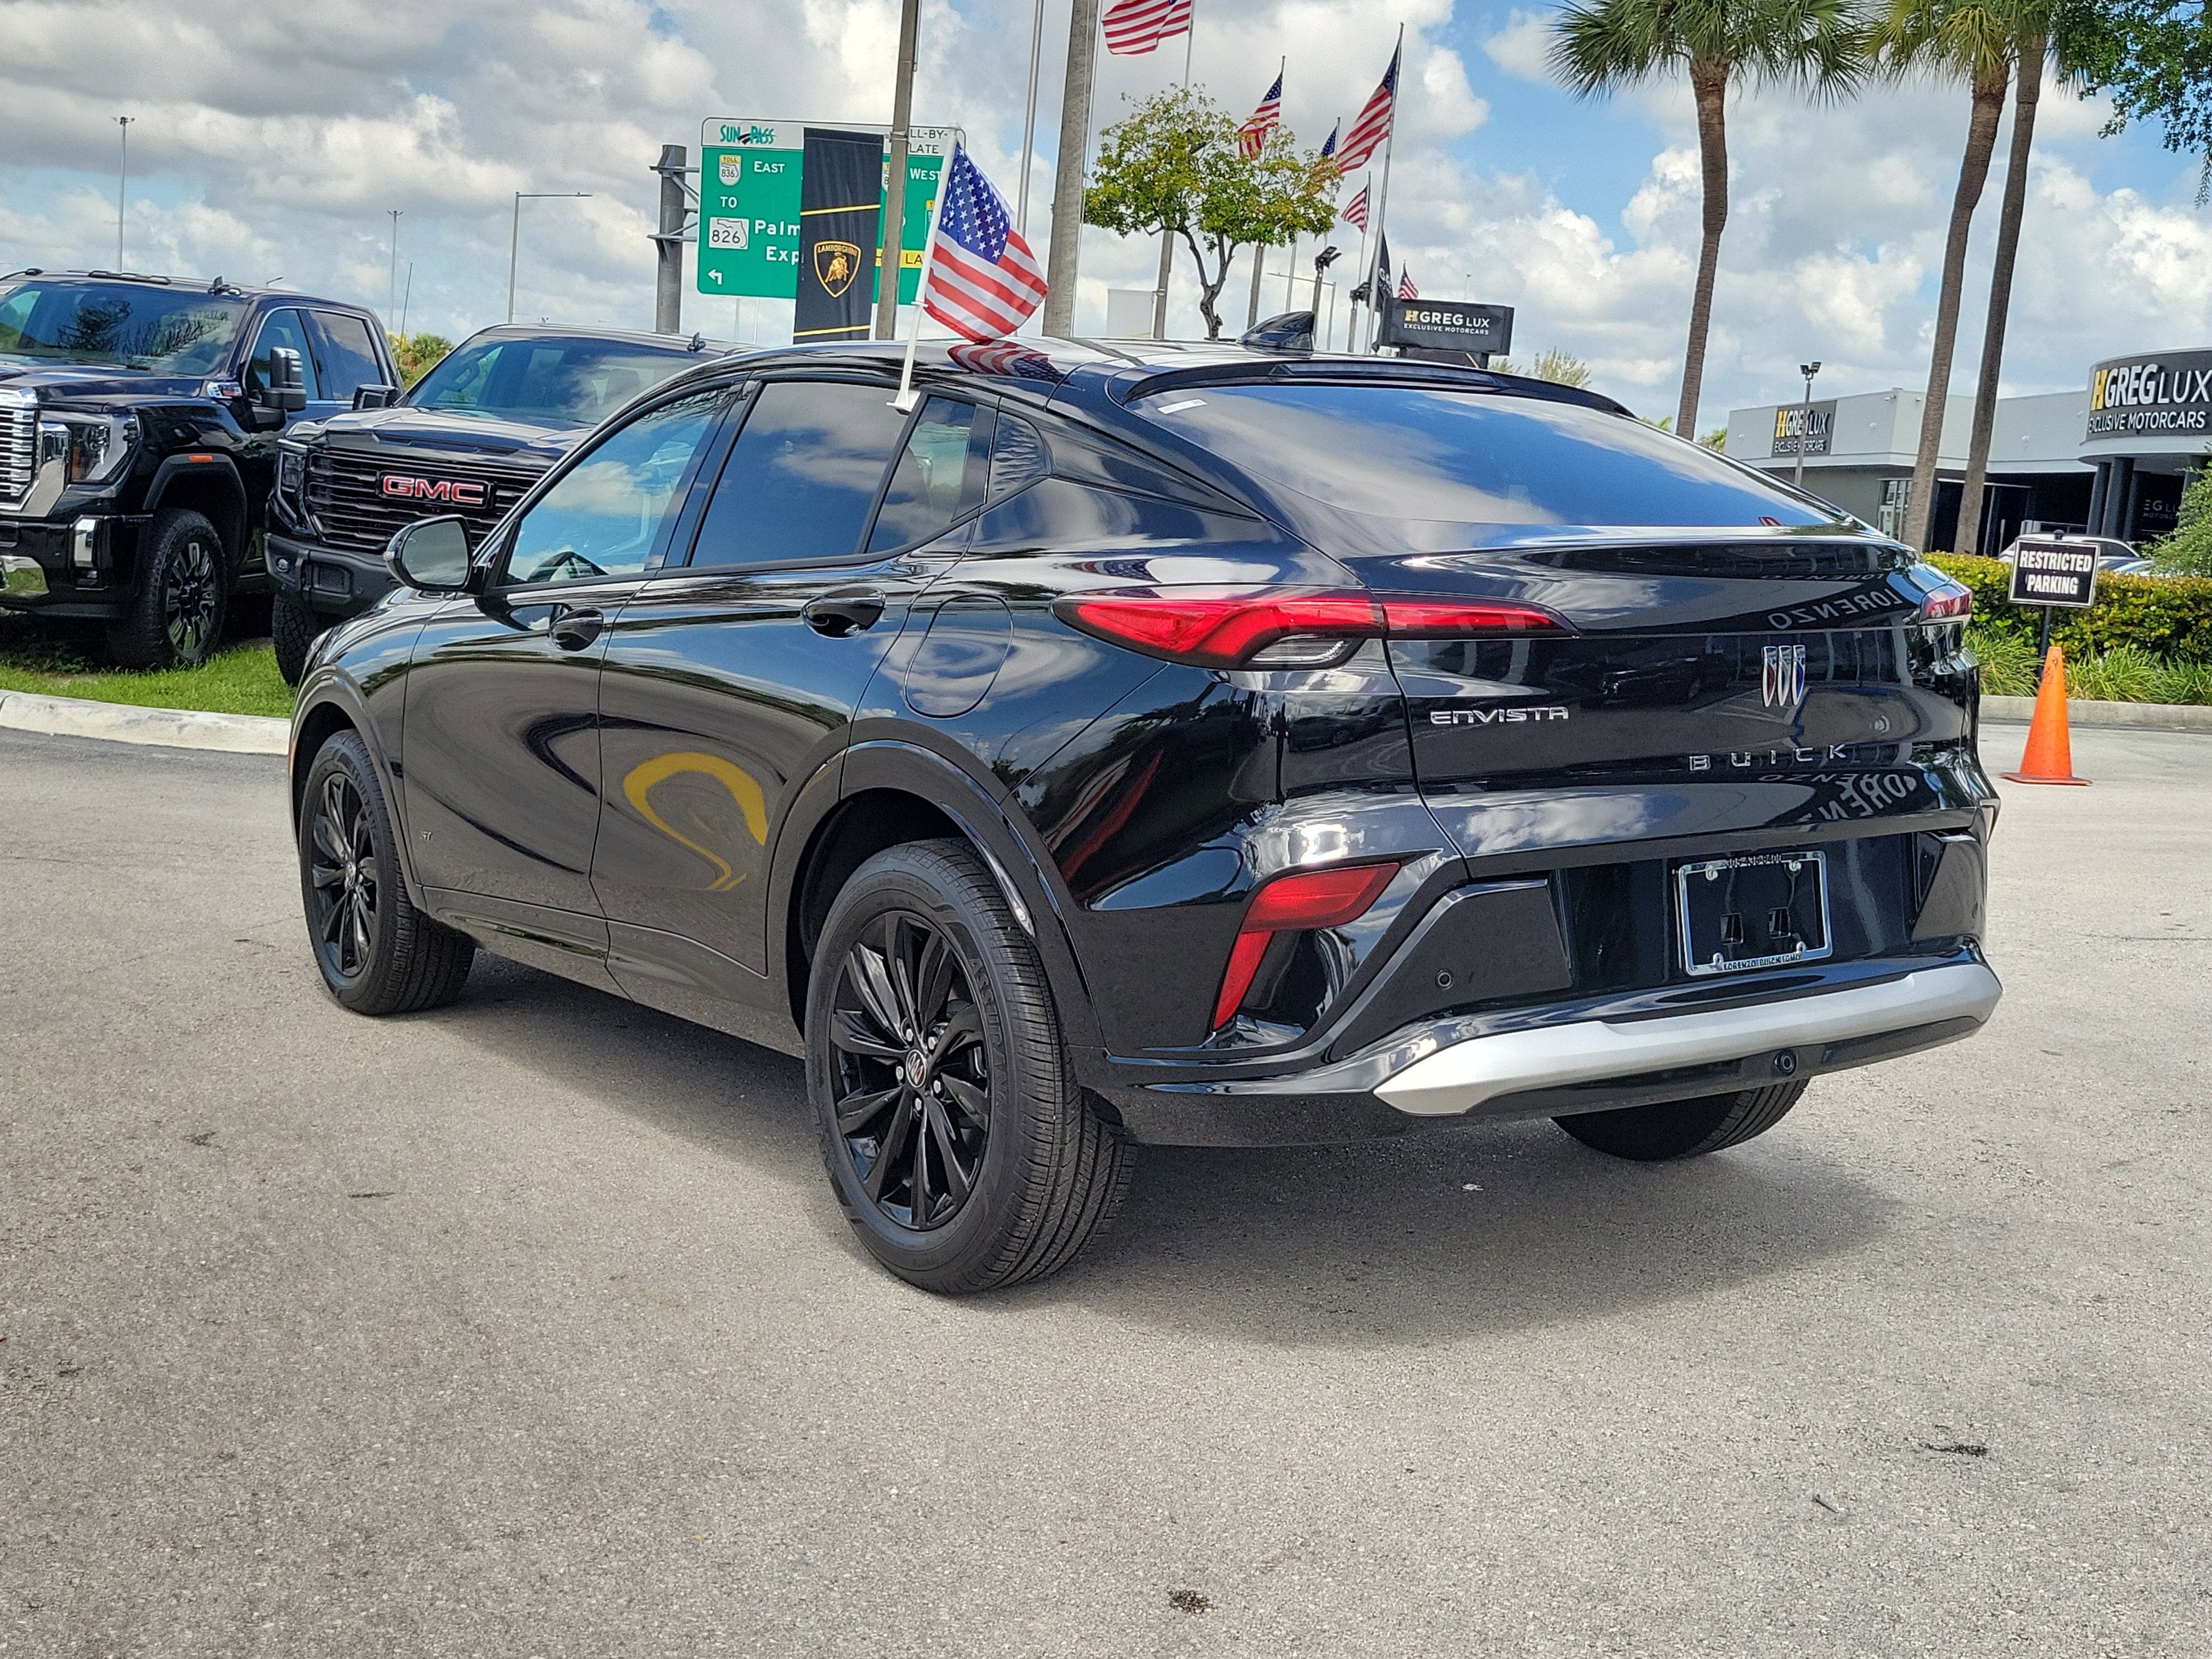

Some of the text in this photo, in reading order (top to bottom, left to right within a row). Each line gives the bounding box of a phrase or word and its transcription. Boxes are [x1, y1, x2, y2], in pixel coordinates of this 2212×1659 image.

[911, 129, 947, 139] LL-BY-
[910, 144, 939, 154] LATE
[721, 168, 735, 178] 836
[754, 161, 785, 173] EAST
[720, 196, 737, 208] TO
[754, 219, 800, 236] Palm
[712, 229, 741, 244] 826
[766, 246, 799, 266] Exp
[906, 253, 923, 265] LA
[1403, 323, 1489, 335] EXCLUSIVE MOTORCARS
[1465, 317, 1490, 328] LUX
[2157, 369, 2212, 404] LUX
[1808, 412, 1827, 435] LUX
[2089, 410, 2207, 433] EXCLUSIVE MOTORCARS
[383, 475, 484, 505] GMC
[2019, 550, 2093, 573] RESTRICTED
[2025, 573, 2079, 595] PARKING
[1430, 706, 1569, 725] ENVISTA
[1689, 743, 1847, 771] BUICK
[1723, 960, 1756, 970] LORENZO
[1759, 956, 1781, 966] BUICK
